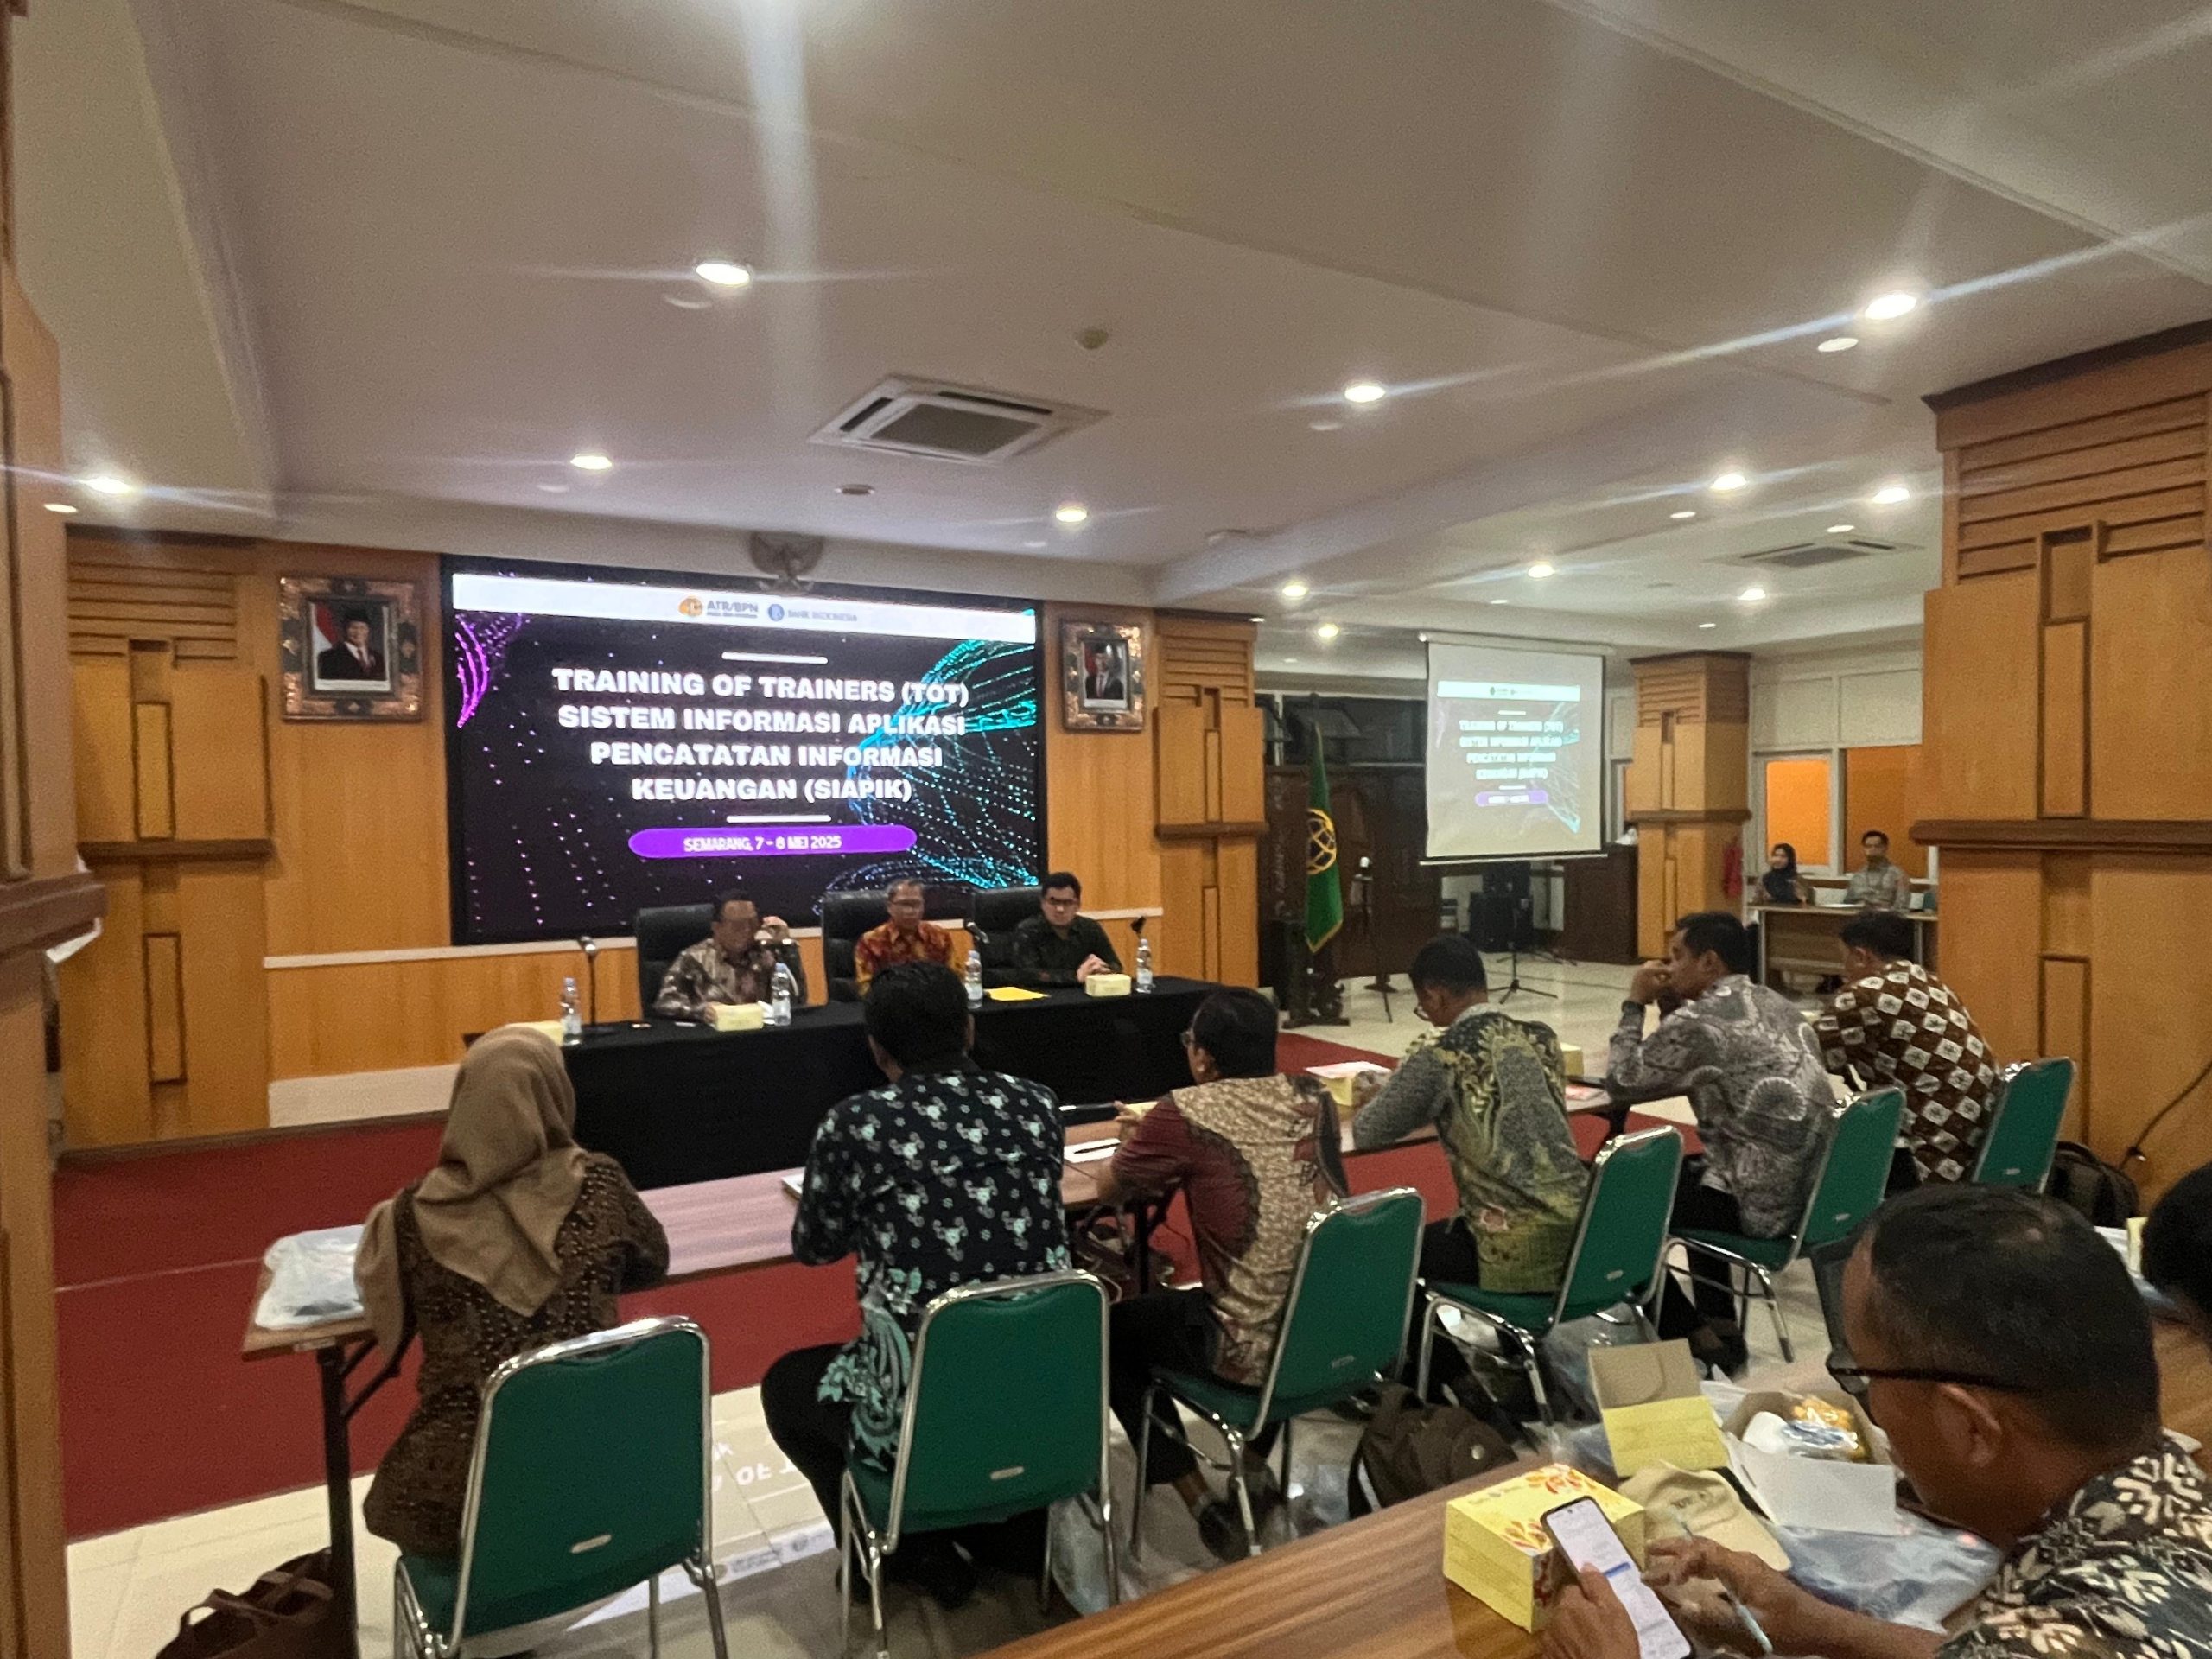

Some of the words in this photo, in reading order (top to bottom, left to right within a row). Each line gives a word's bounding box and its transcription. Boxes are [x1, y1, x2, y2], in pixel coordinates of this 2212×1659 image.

[707, 600, 758, 613] ATR/BPN
[552, 668, 704, 696] TRAINING
[712, 674, 751, 696] OF
[760, 676, 894, 702] TRAINERS
[902, 682, 969, 707] (TOT)
[559, 705, 675, 728] SISTEM
[684, 709, 840, 733] INFORMASI
[848, 714, 965, 735] APLIKASI
[591, 742, 791, 766] PENCATATAN
[799, 746, 943, 766] INFORMASI
[632, 779, 797, 800] KEUANGAN
[804, 779, 912, 803] (SIAPIK)
[683, 837, 753, 852] SEMARANG,
[755, 836, 763, 849] 7
[787, 836, 808, 849] MEI
[810, 835, 842, 849] 2025
